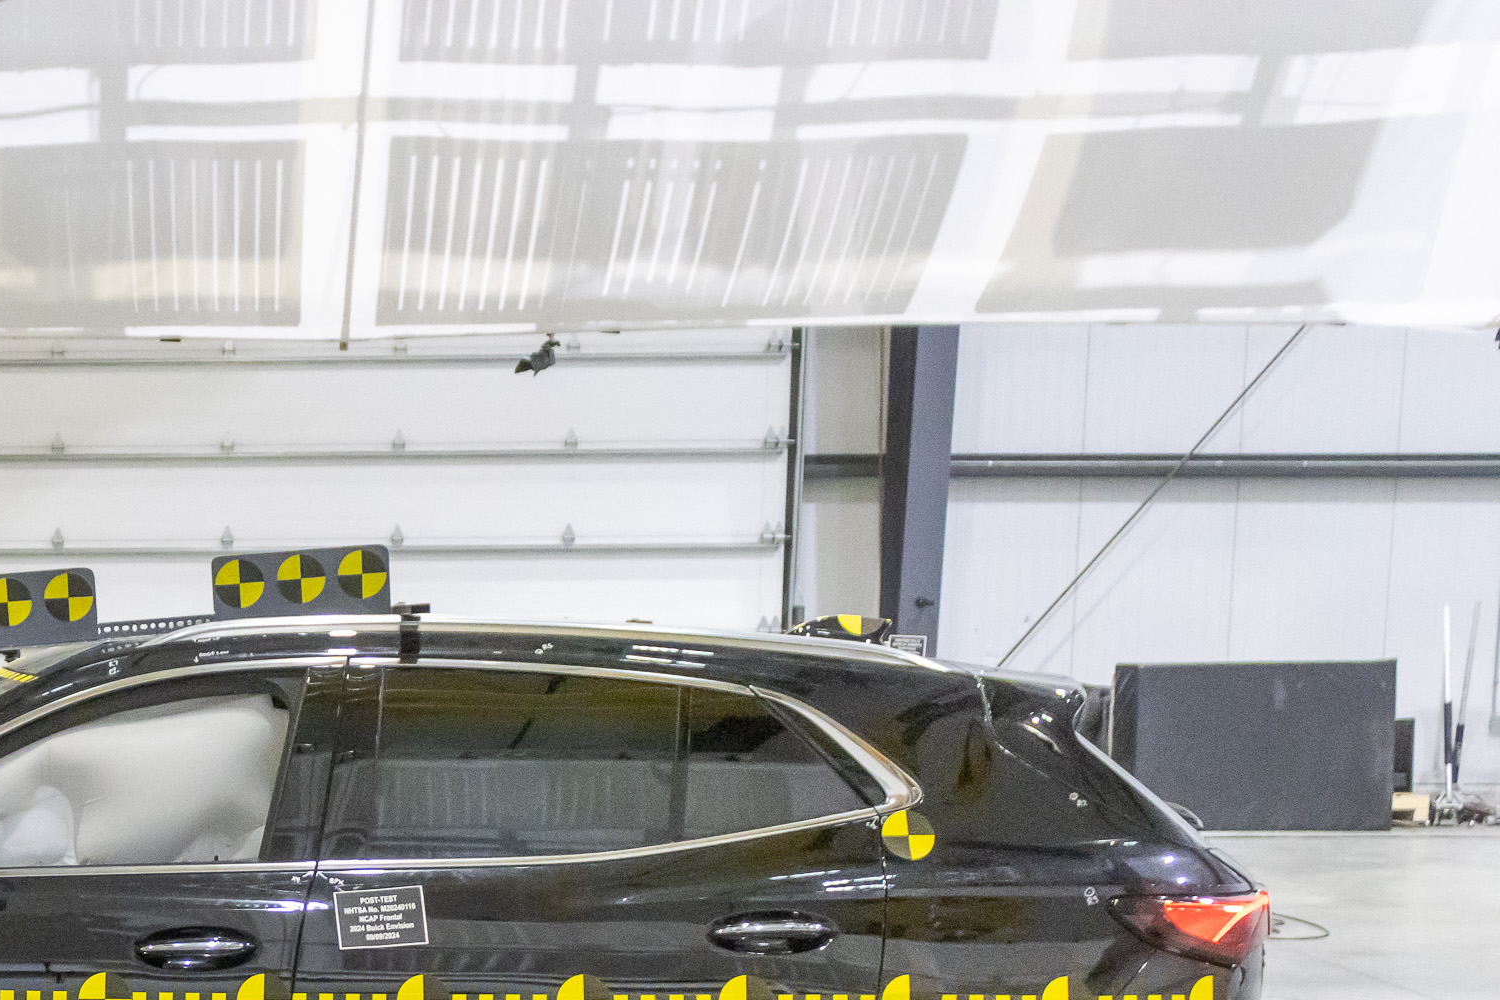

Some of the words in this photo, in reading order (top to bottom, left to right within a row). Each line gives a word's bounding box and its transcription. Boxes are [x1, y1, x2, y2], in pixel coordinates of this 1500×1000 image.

[360, 894, 398, 904] POST-TEST
[344, 906, 368, 914] NHTSA
[359, 914, 378, 923] NCAP
[379, 913, 402, 921] Frontal
[350, 924, 365, 932] 2024
[366, 923, 385, 931] Buick
[386, 922, 414, 930] Envision
